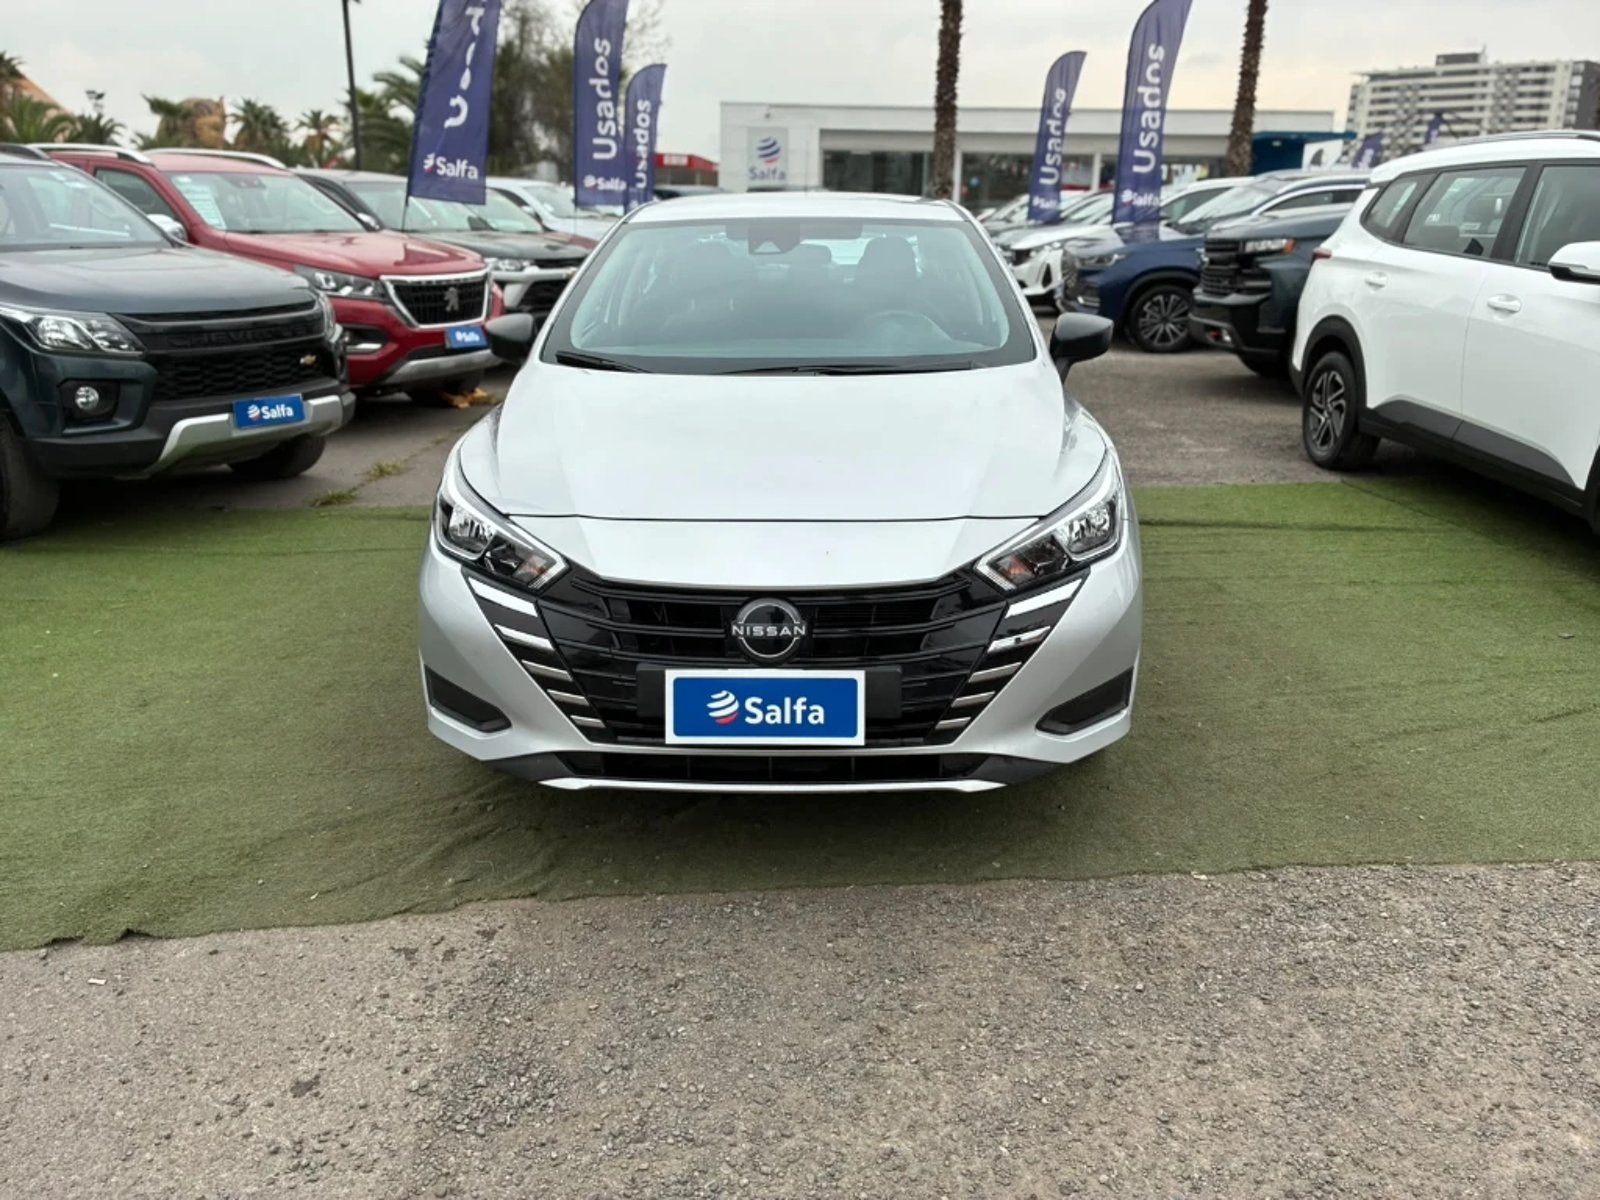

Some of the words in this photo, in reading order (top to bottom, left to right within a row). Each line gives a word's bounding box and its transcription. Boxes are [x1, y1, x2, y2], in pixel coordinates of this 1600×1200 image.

[589, 37, 617, 160] Usados
[436, 156, 479, 179] Salfa
[749, 166, 786, 180] Salfa
[597, 177, 627, 191] Salfa
[262, 405, 294, 419] Salfa
[731, 624, 806, 637] NISSAN
[744, 696, 825, 725] Salfa
